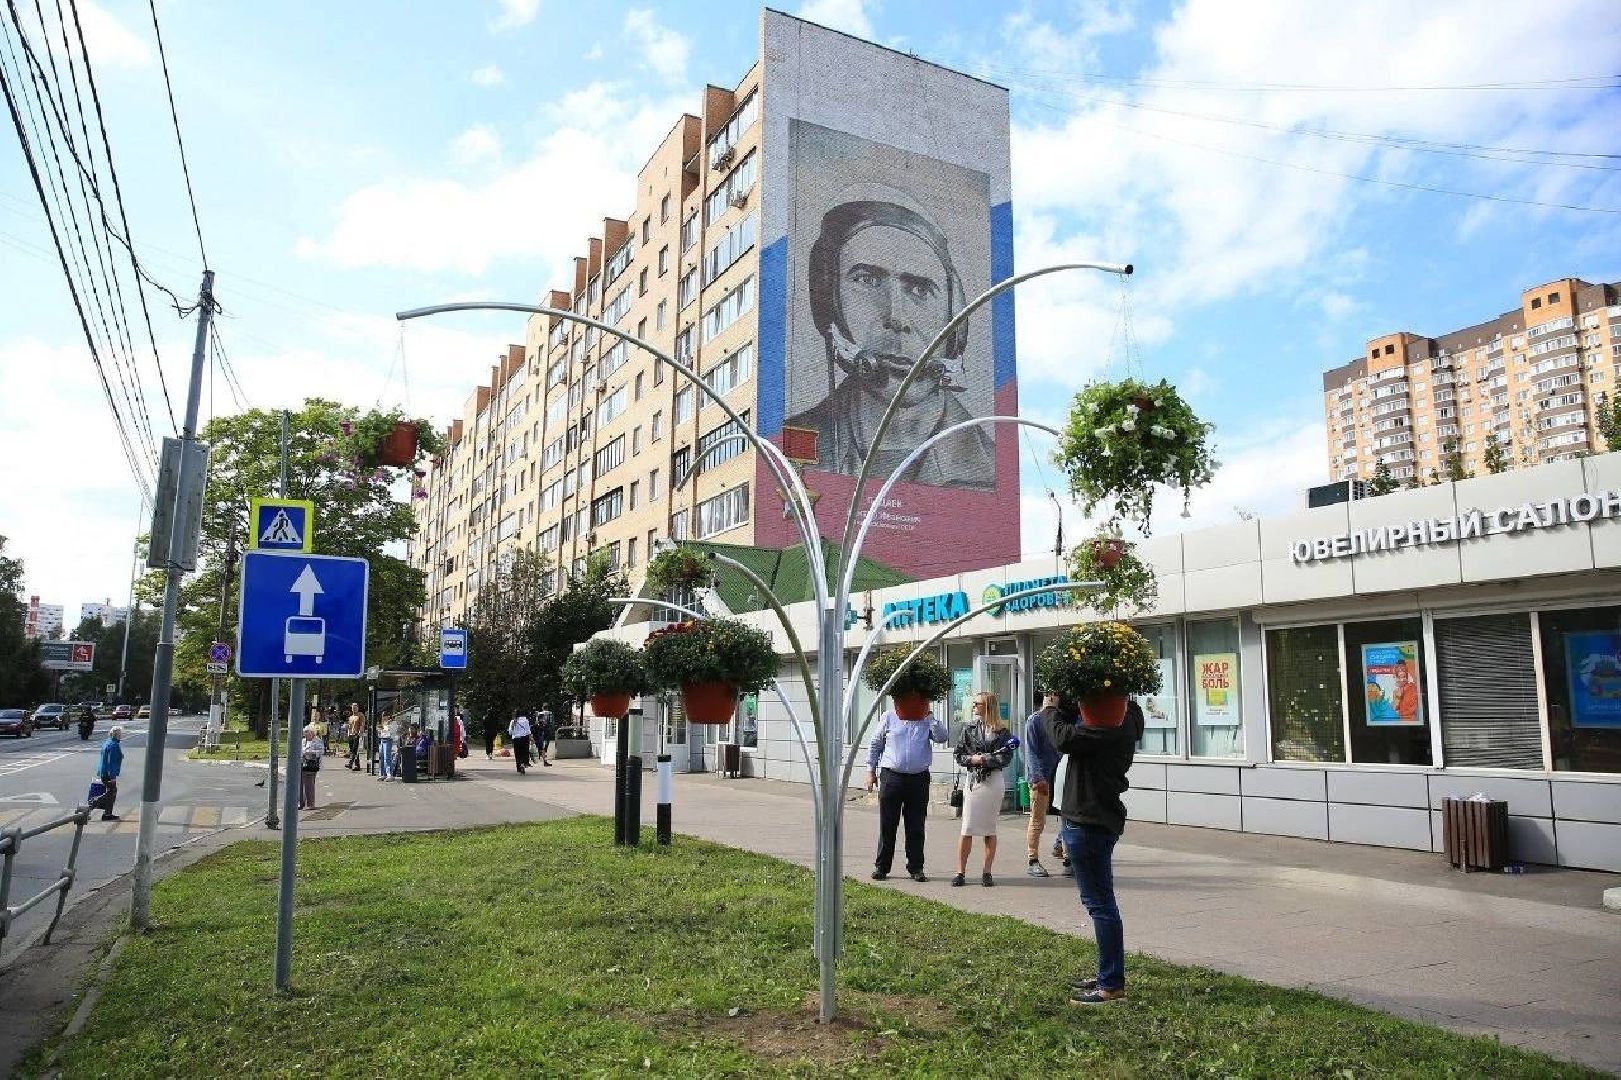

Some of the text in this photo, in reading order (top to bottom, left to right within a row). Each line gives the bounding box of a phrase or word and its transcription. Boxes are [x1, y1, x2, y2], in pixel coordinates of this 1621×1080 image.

[1288, 489, 1621, 563] ЮВЕЛИРНЫЙ САЛОН
[883, 591, 969, 627] АПТЕКА
[1202, 662, 1229, 675] ЖАР
[1202, 678, 1230, 689] БОЛЬ
